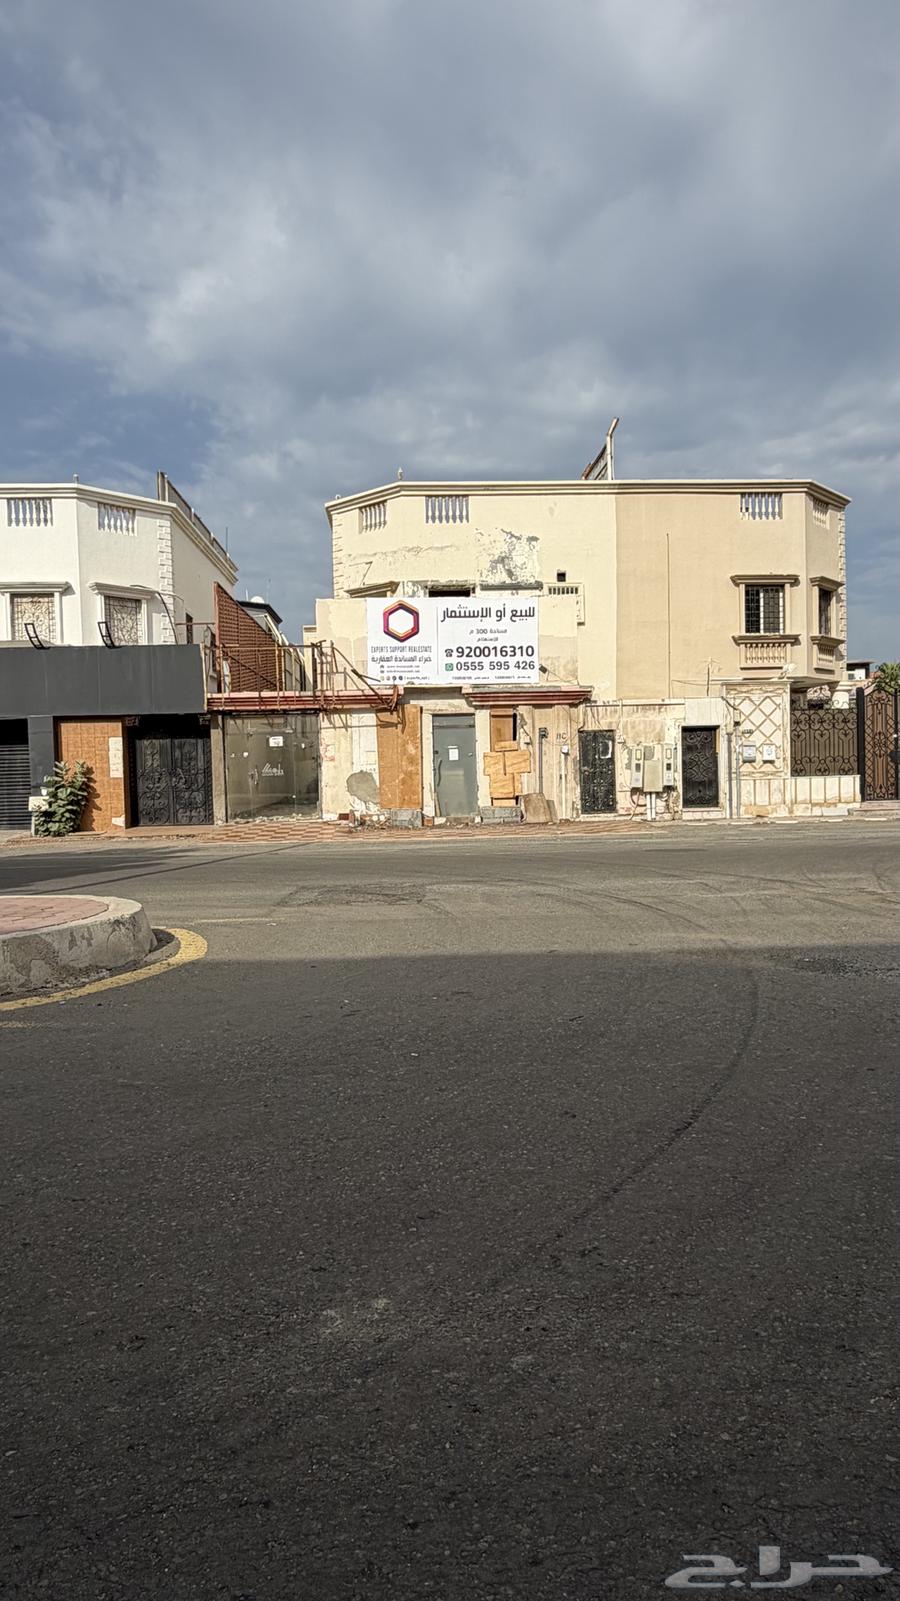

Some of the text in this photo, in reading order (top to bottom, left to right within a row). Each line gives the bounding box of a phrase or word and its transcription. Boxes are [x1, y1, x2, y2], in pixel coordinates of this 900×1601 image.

[440, 603, 535, 622] للبيع أو الإستثمار
[455, 645, 535, 658] 920016310
[371, 655, 393, 664] العقارية
[455, 660, 535, 671] 0555 595 426
